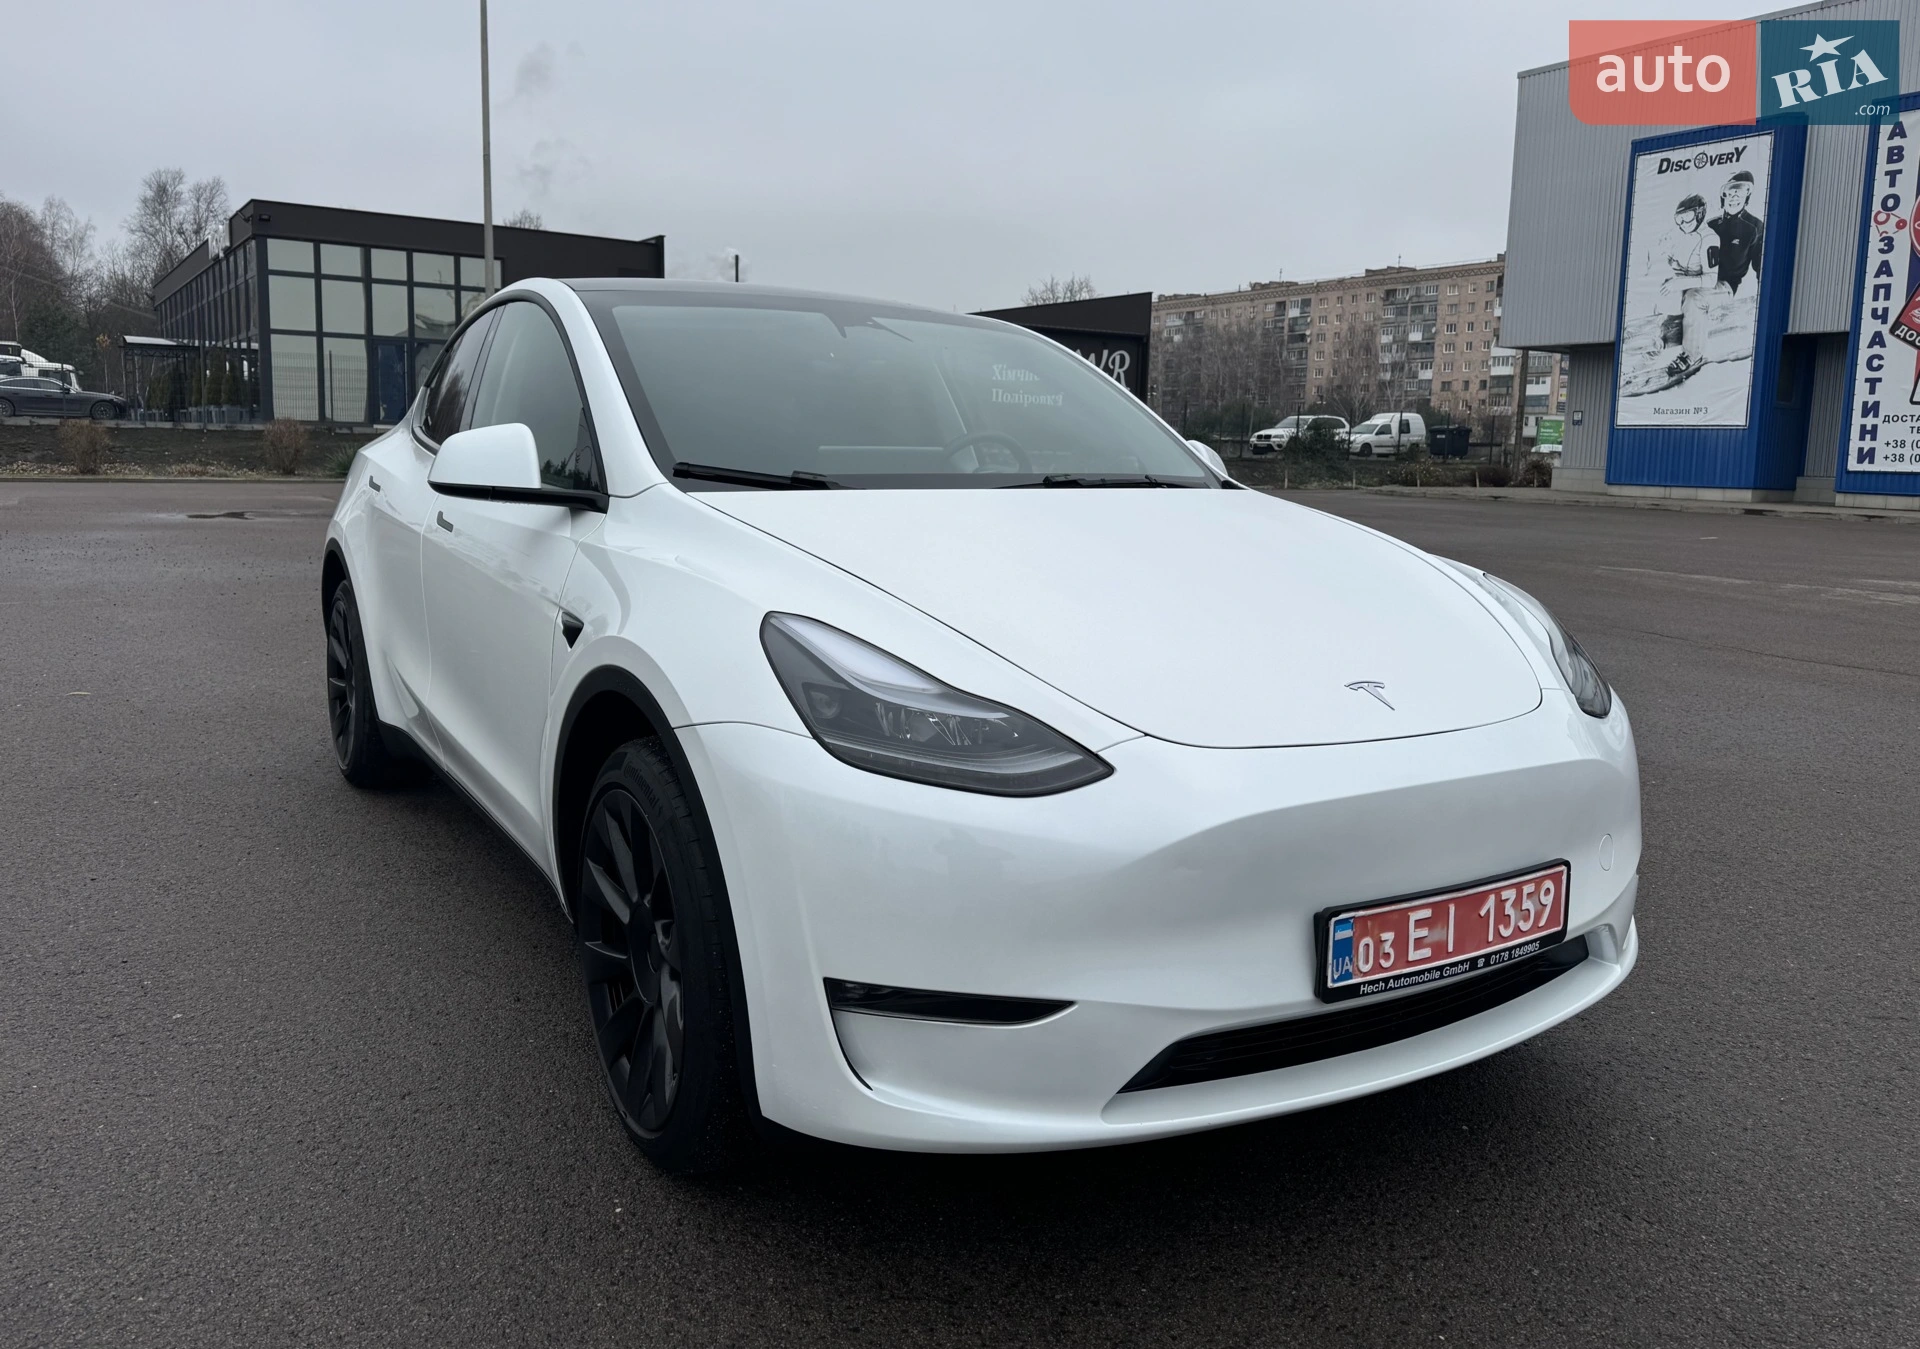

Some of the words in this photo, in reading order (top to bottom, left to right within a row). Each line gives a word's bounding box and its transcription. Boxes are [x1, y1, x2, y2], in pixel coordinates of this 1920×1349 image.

[1653, 407, 1690, 415] Магазин
[1884, 439, 1907, 449] +38
[1882, 453, 1905, 463] +38
[1357, 931, 1395, 974] 03
[1407, 903, 1455, 962] EI
[1479, 879, 1555, 943] 1359
[1333, 956, 1353, 979] UA
[1359, 982, 1386, 995] Hech
[1387, 971, 1440, 988] Automobile
[1442, 961, 1470, 977] GmbH
[1490, 952, 1509, 965] 0178
[1510, 941, 1540, 959] 1849905
